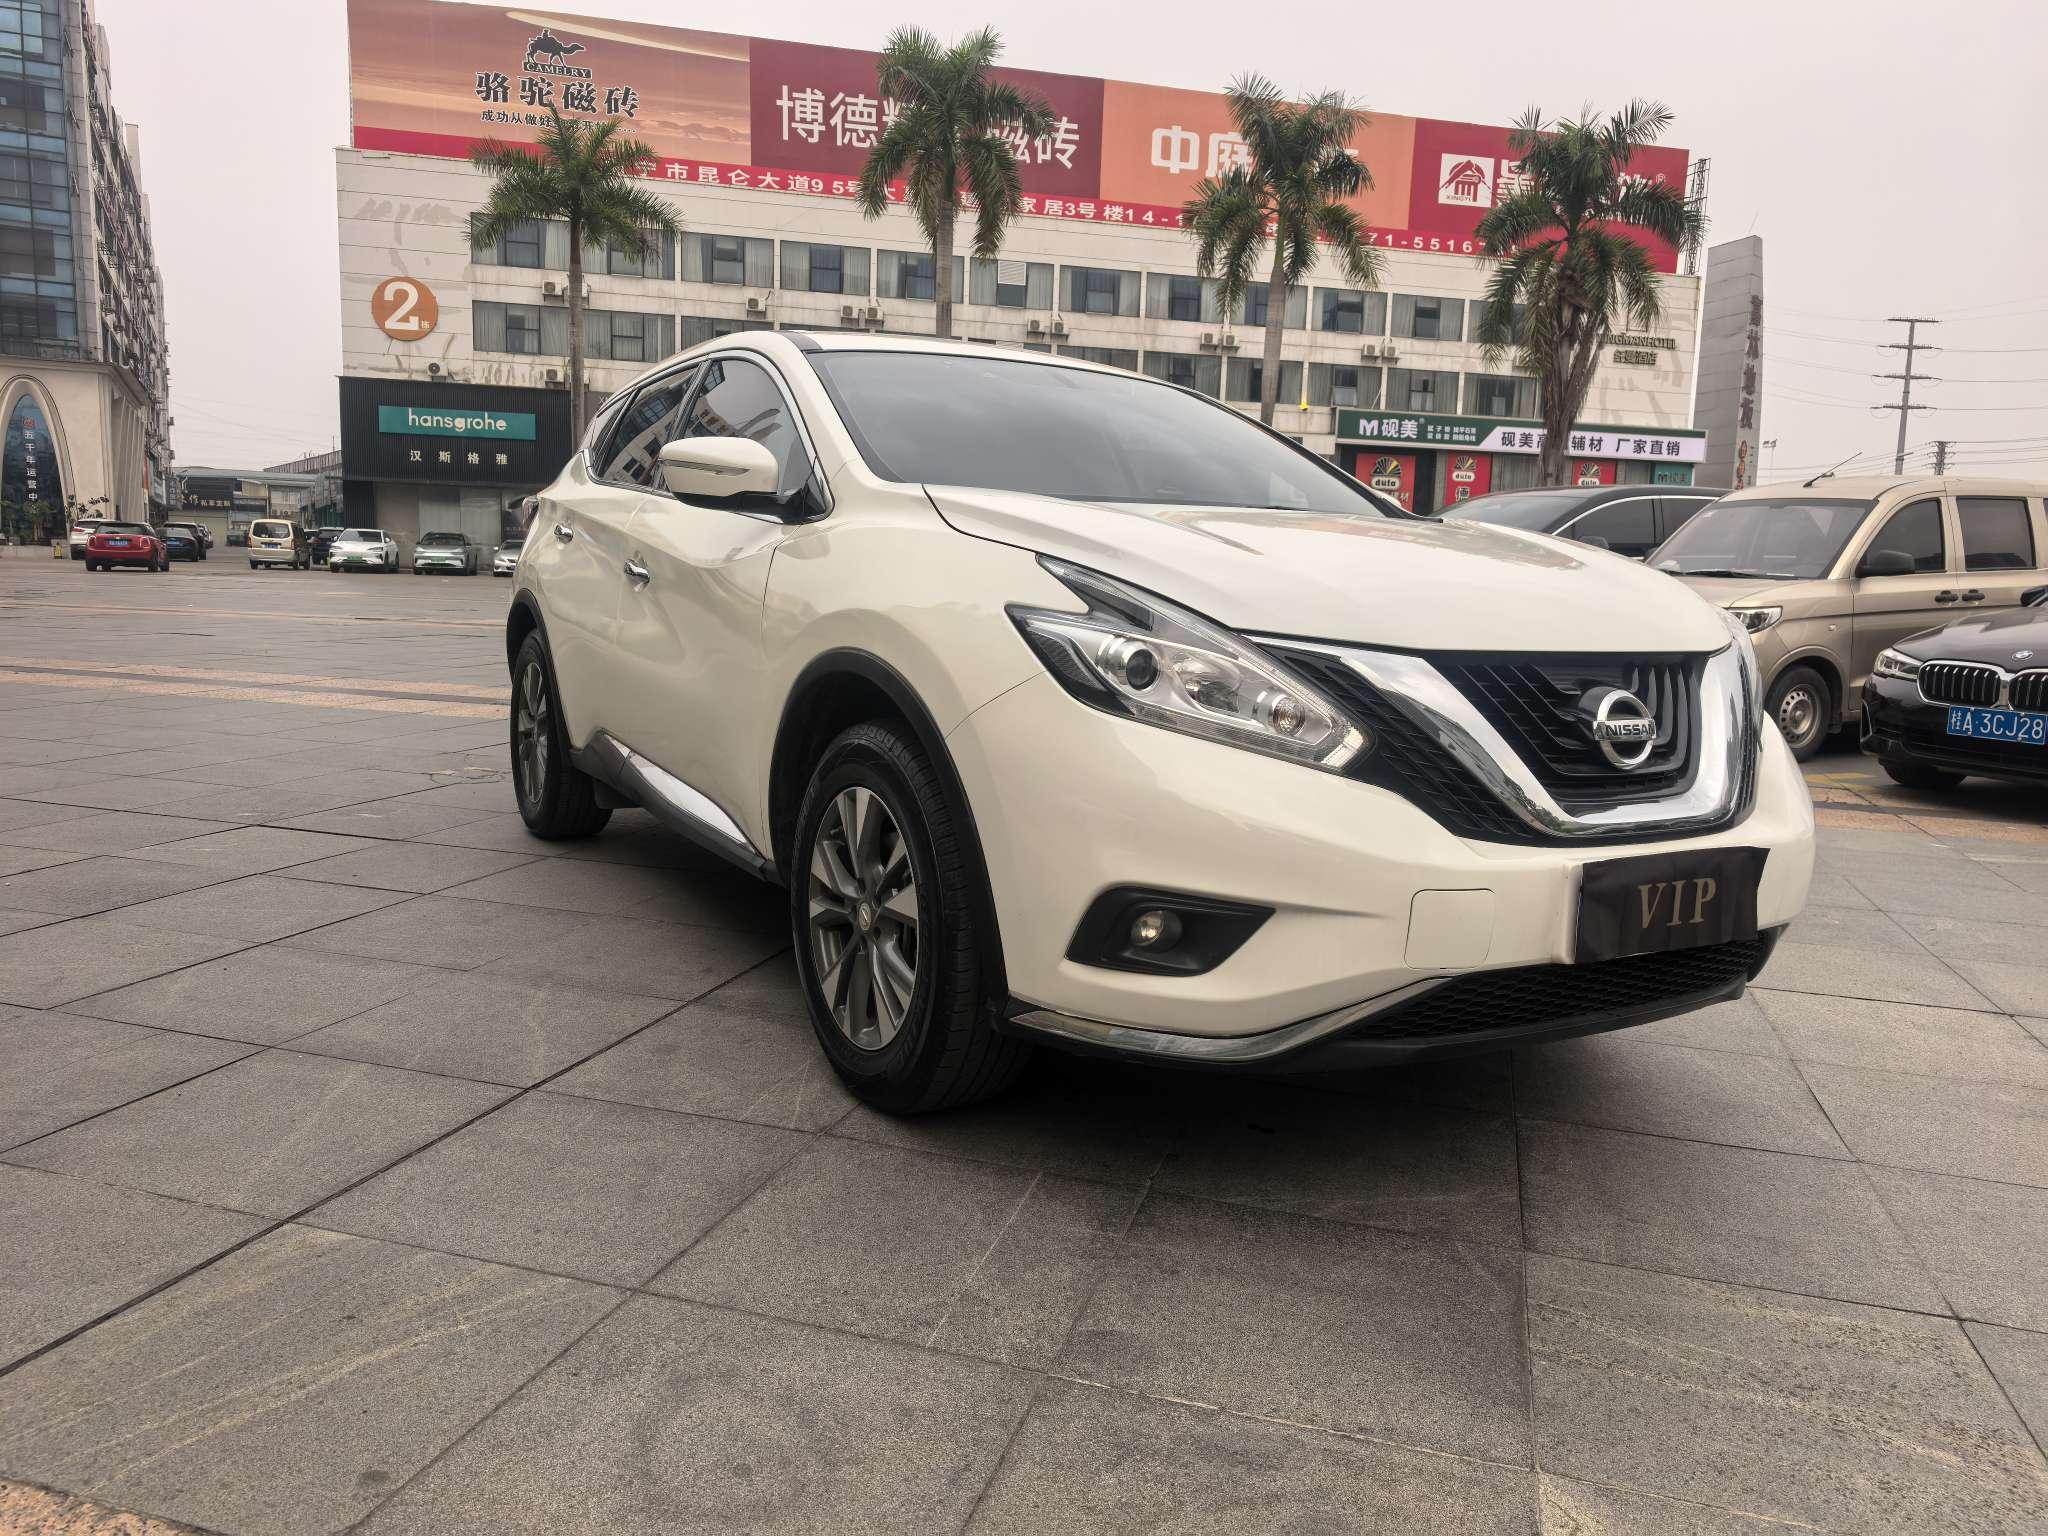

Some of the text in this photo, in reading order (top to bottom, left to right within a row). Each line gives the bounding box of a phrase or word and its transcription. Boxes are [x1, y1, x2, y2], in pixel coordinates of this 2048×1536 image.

[526, 63, 588, 78] CAMELRY
[476, 72, 639, 117] 骆驼磁砖
[408, 407, 507, 432] hansgrohe
[1616, 438, 1681, 456] 厂家直销
[410, 450, 508, 465] 汉斯格雅
[1605, 723, 1656, 737] NISSAN
[1638, 877, 1717, 929] VIP
